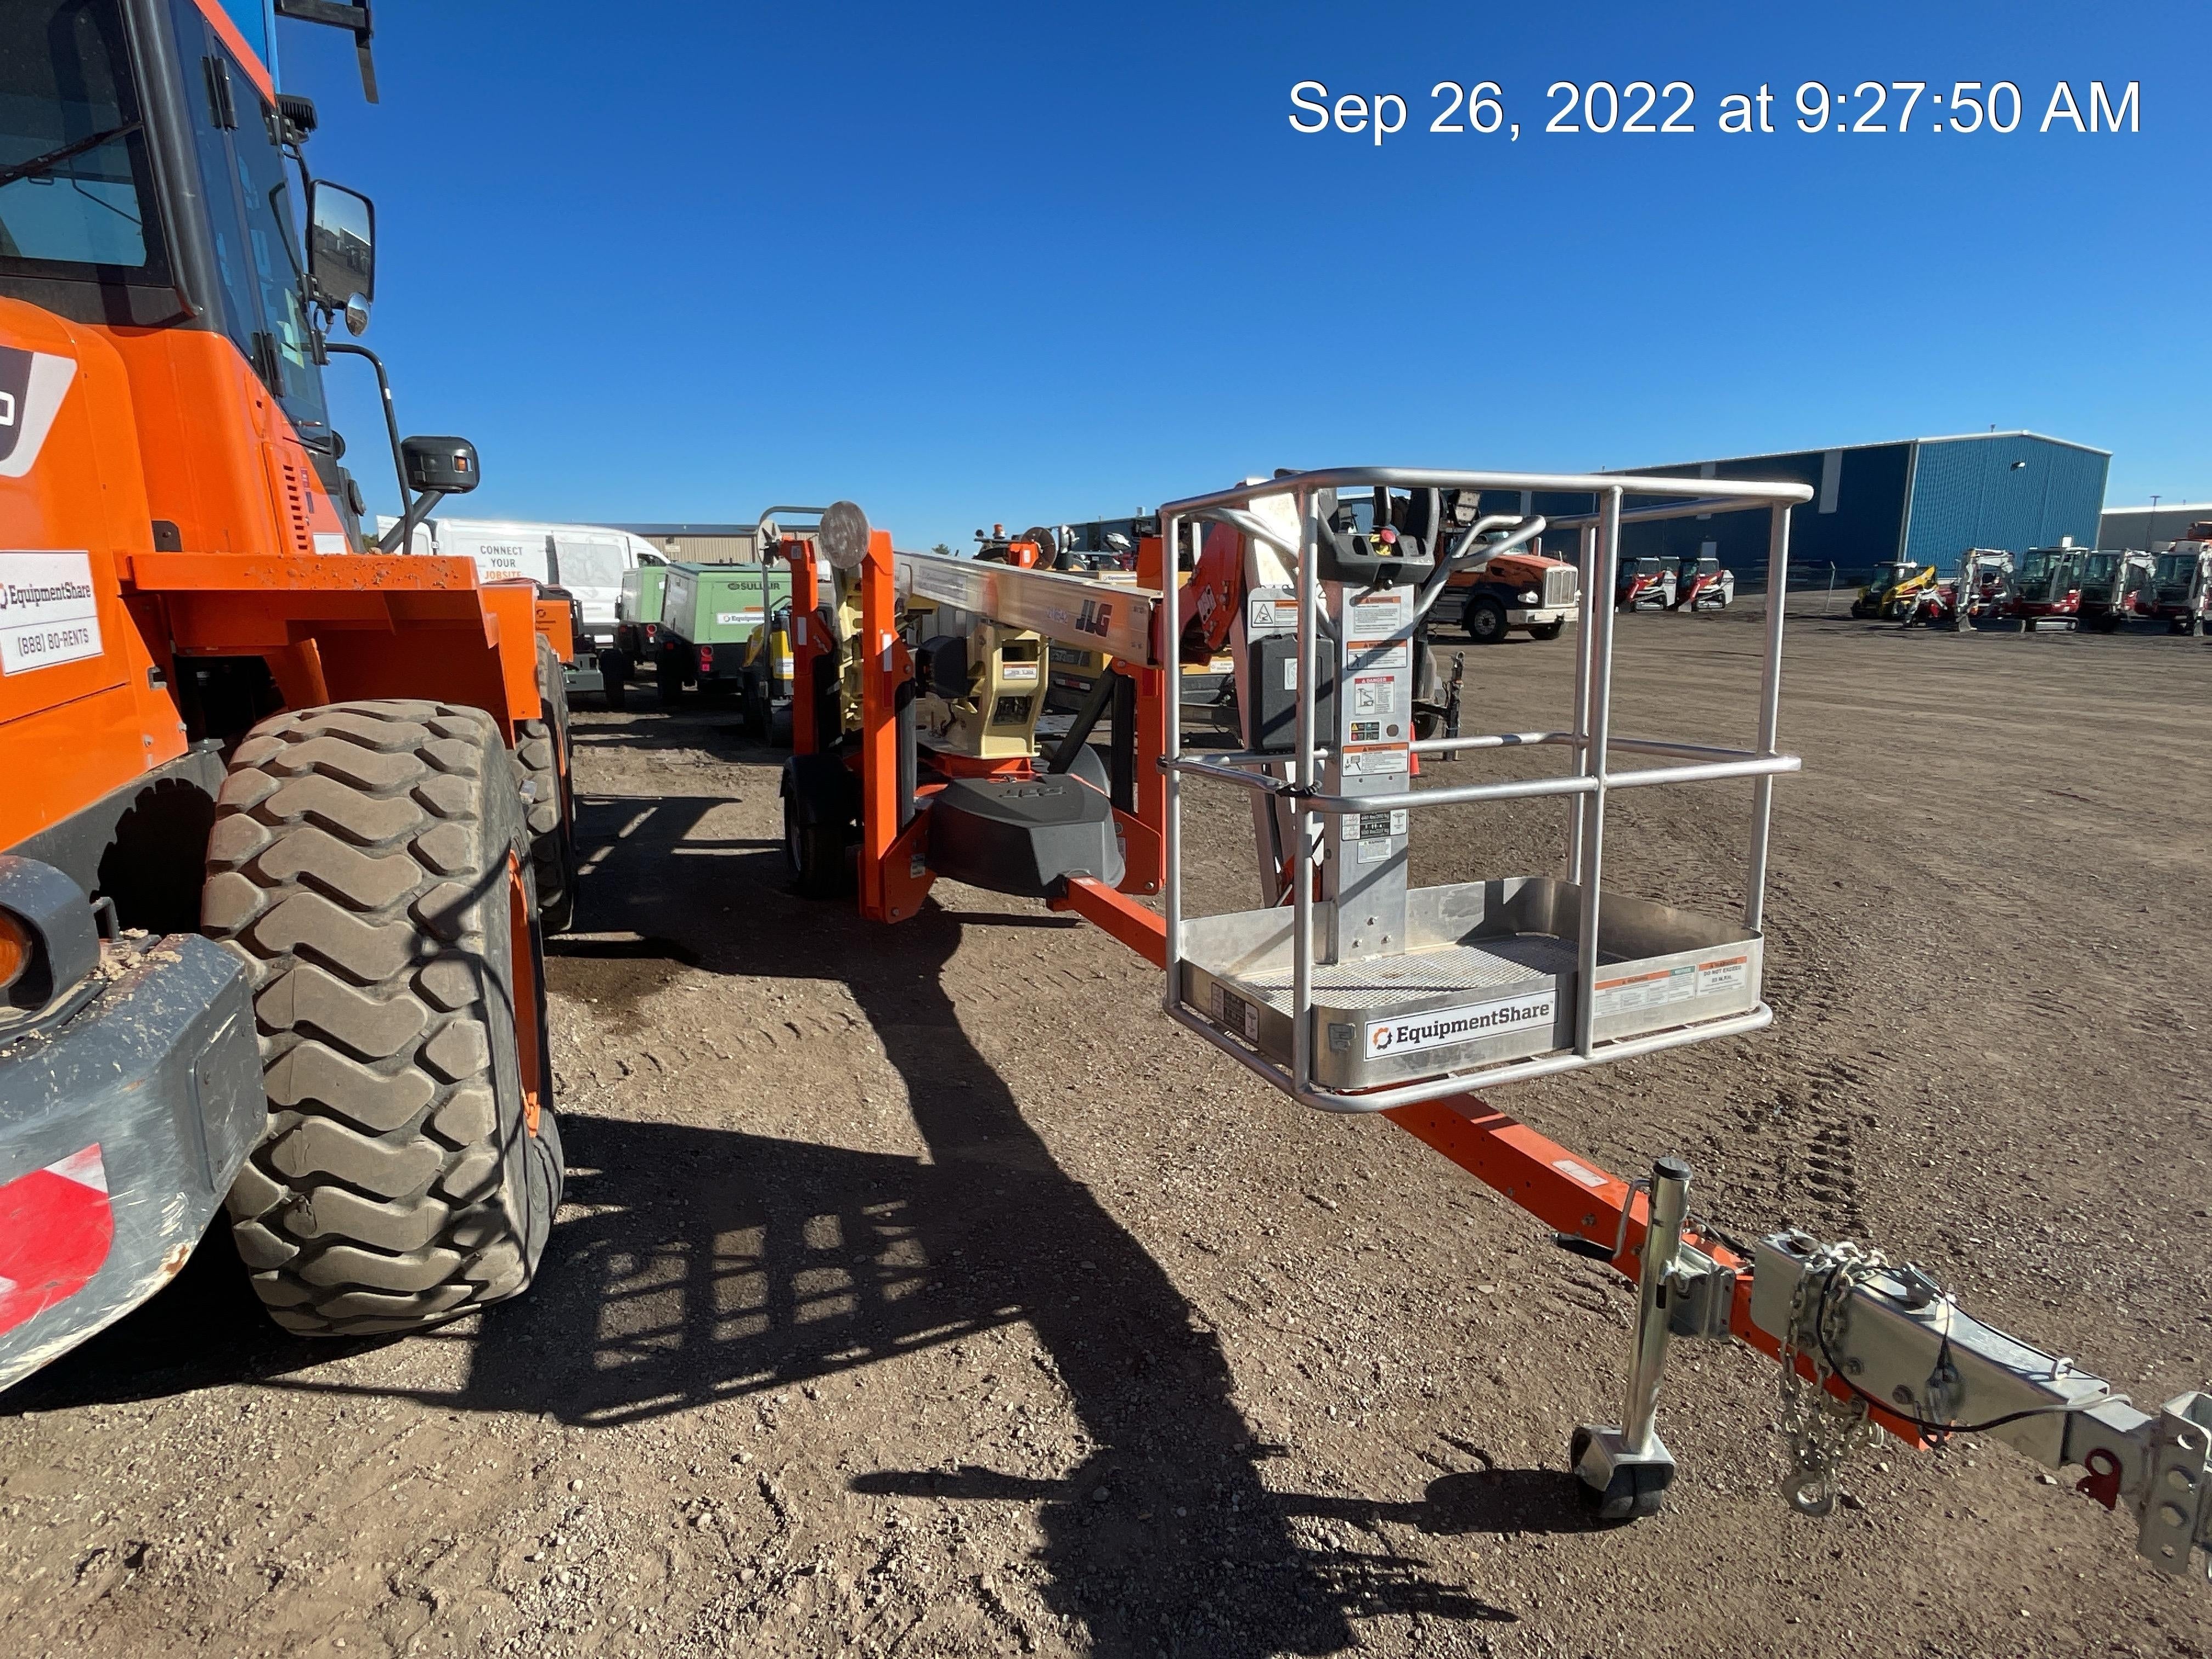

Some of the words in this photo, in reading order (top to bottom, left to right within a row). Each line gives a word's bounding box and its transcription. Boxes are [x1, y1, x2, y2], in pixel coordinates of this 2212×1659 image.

[479, 545, 523, 555] CONNECT
[491, 558, 516, 567] YOUR
[8, 582, 91, 608] EquipmentShare
[1075, 599, 1113, 637] JLG
[18, 633, 46, 657] (888)
[47, 628, 89, 650] 80-RENTS
[1396, 1003, 1550, 1044] EquipmentShare
